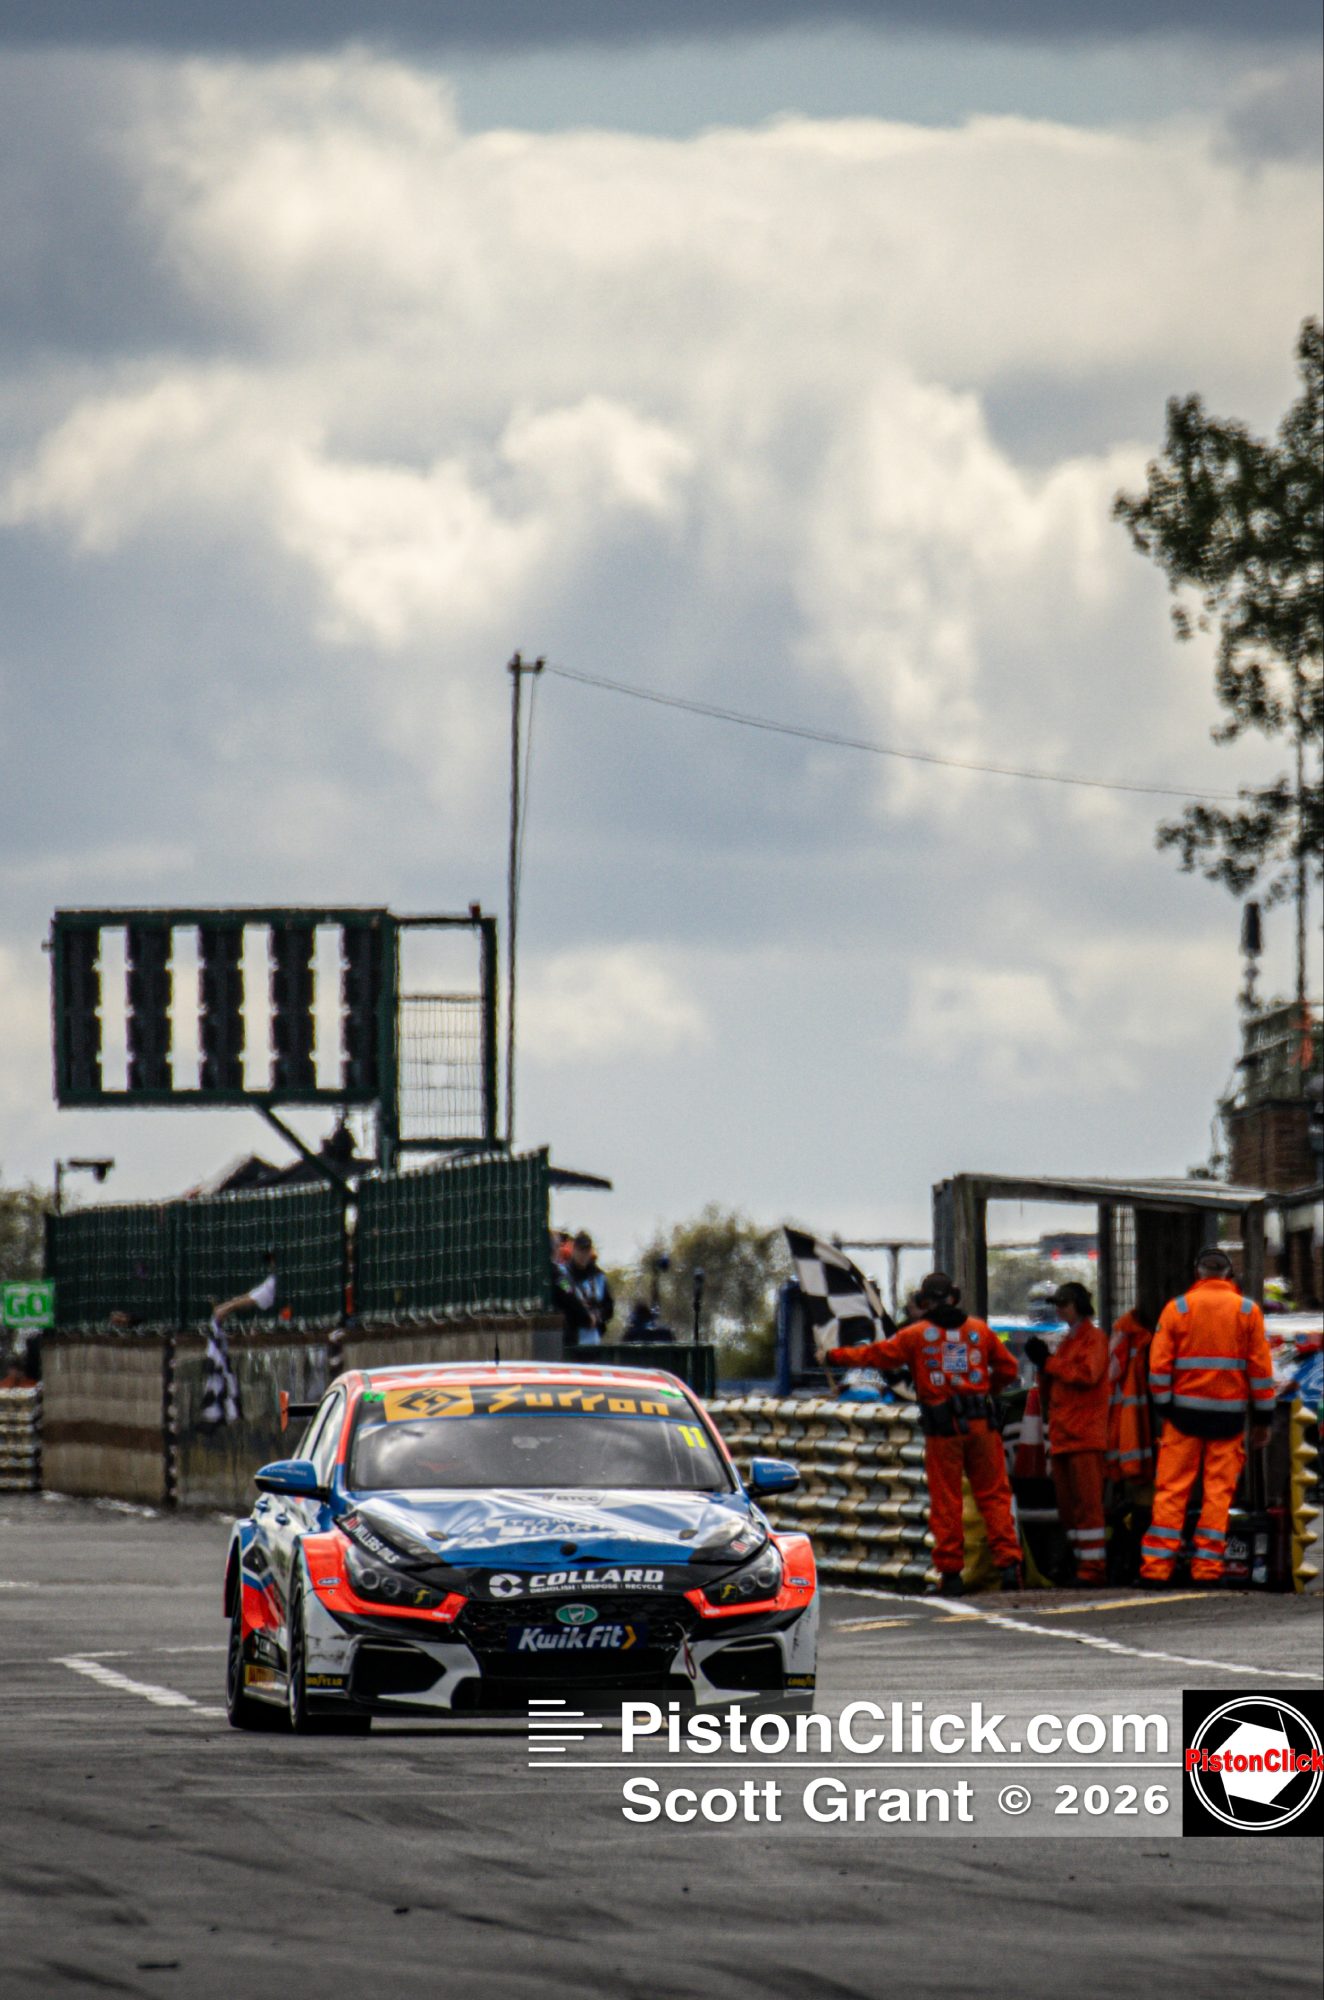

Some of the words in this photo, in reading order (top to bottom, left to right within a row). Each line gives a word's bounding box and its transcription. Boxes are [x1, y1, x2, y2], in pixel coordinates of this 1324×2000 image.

[6, 1293, 48, 1319] GO
[489, 1385, 669, 1416] Surron
[677, 1425, 707, 1449] 11
[529, 1569, 664, 1588] COLLARD
[529, 1584, 576, 1594] DEMOLISH
[581, 1582, 618, 1591] DISPOSE
[624, 1582, 664, 1592] RECYCLE
